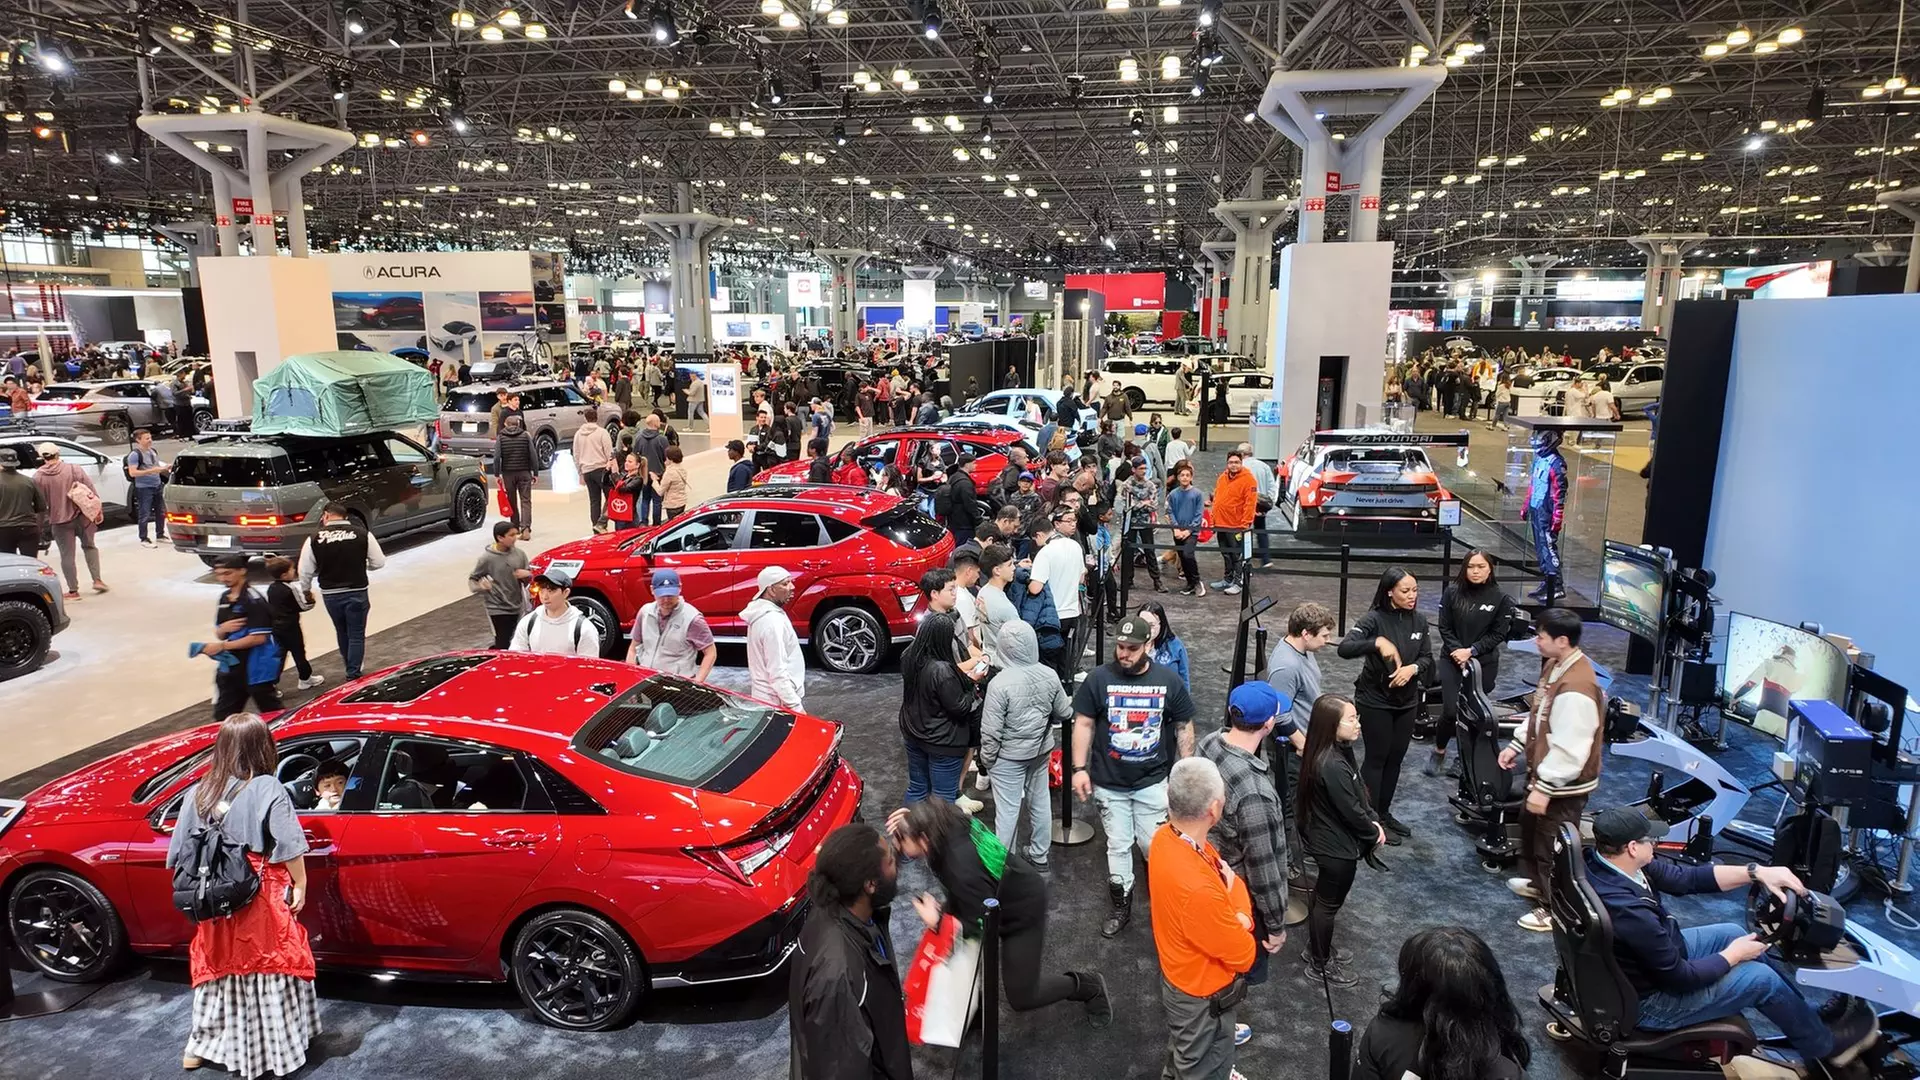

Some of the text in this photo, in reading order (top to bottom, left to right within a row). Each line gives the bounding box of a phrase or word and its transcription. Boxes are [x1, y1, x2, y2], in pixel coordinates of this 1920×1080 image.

[377, 266, 441, 278] ACURA
[1372, 435, 1434, 443] HYUNDAI
[1375, 496, 1387, 504] just
[806, 780, 841, 831] ELANTRA
